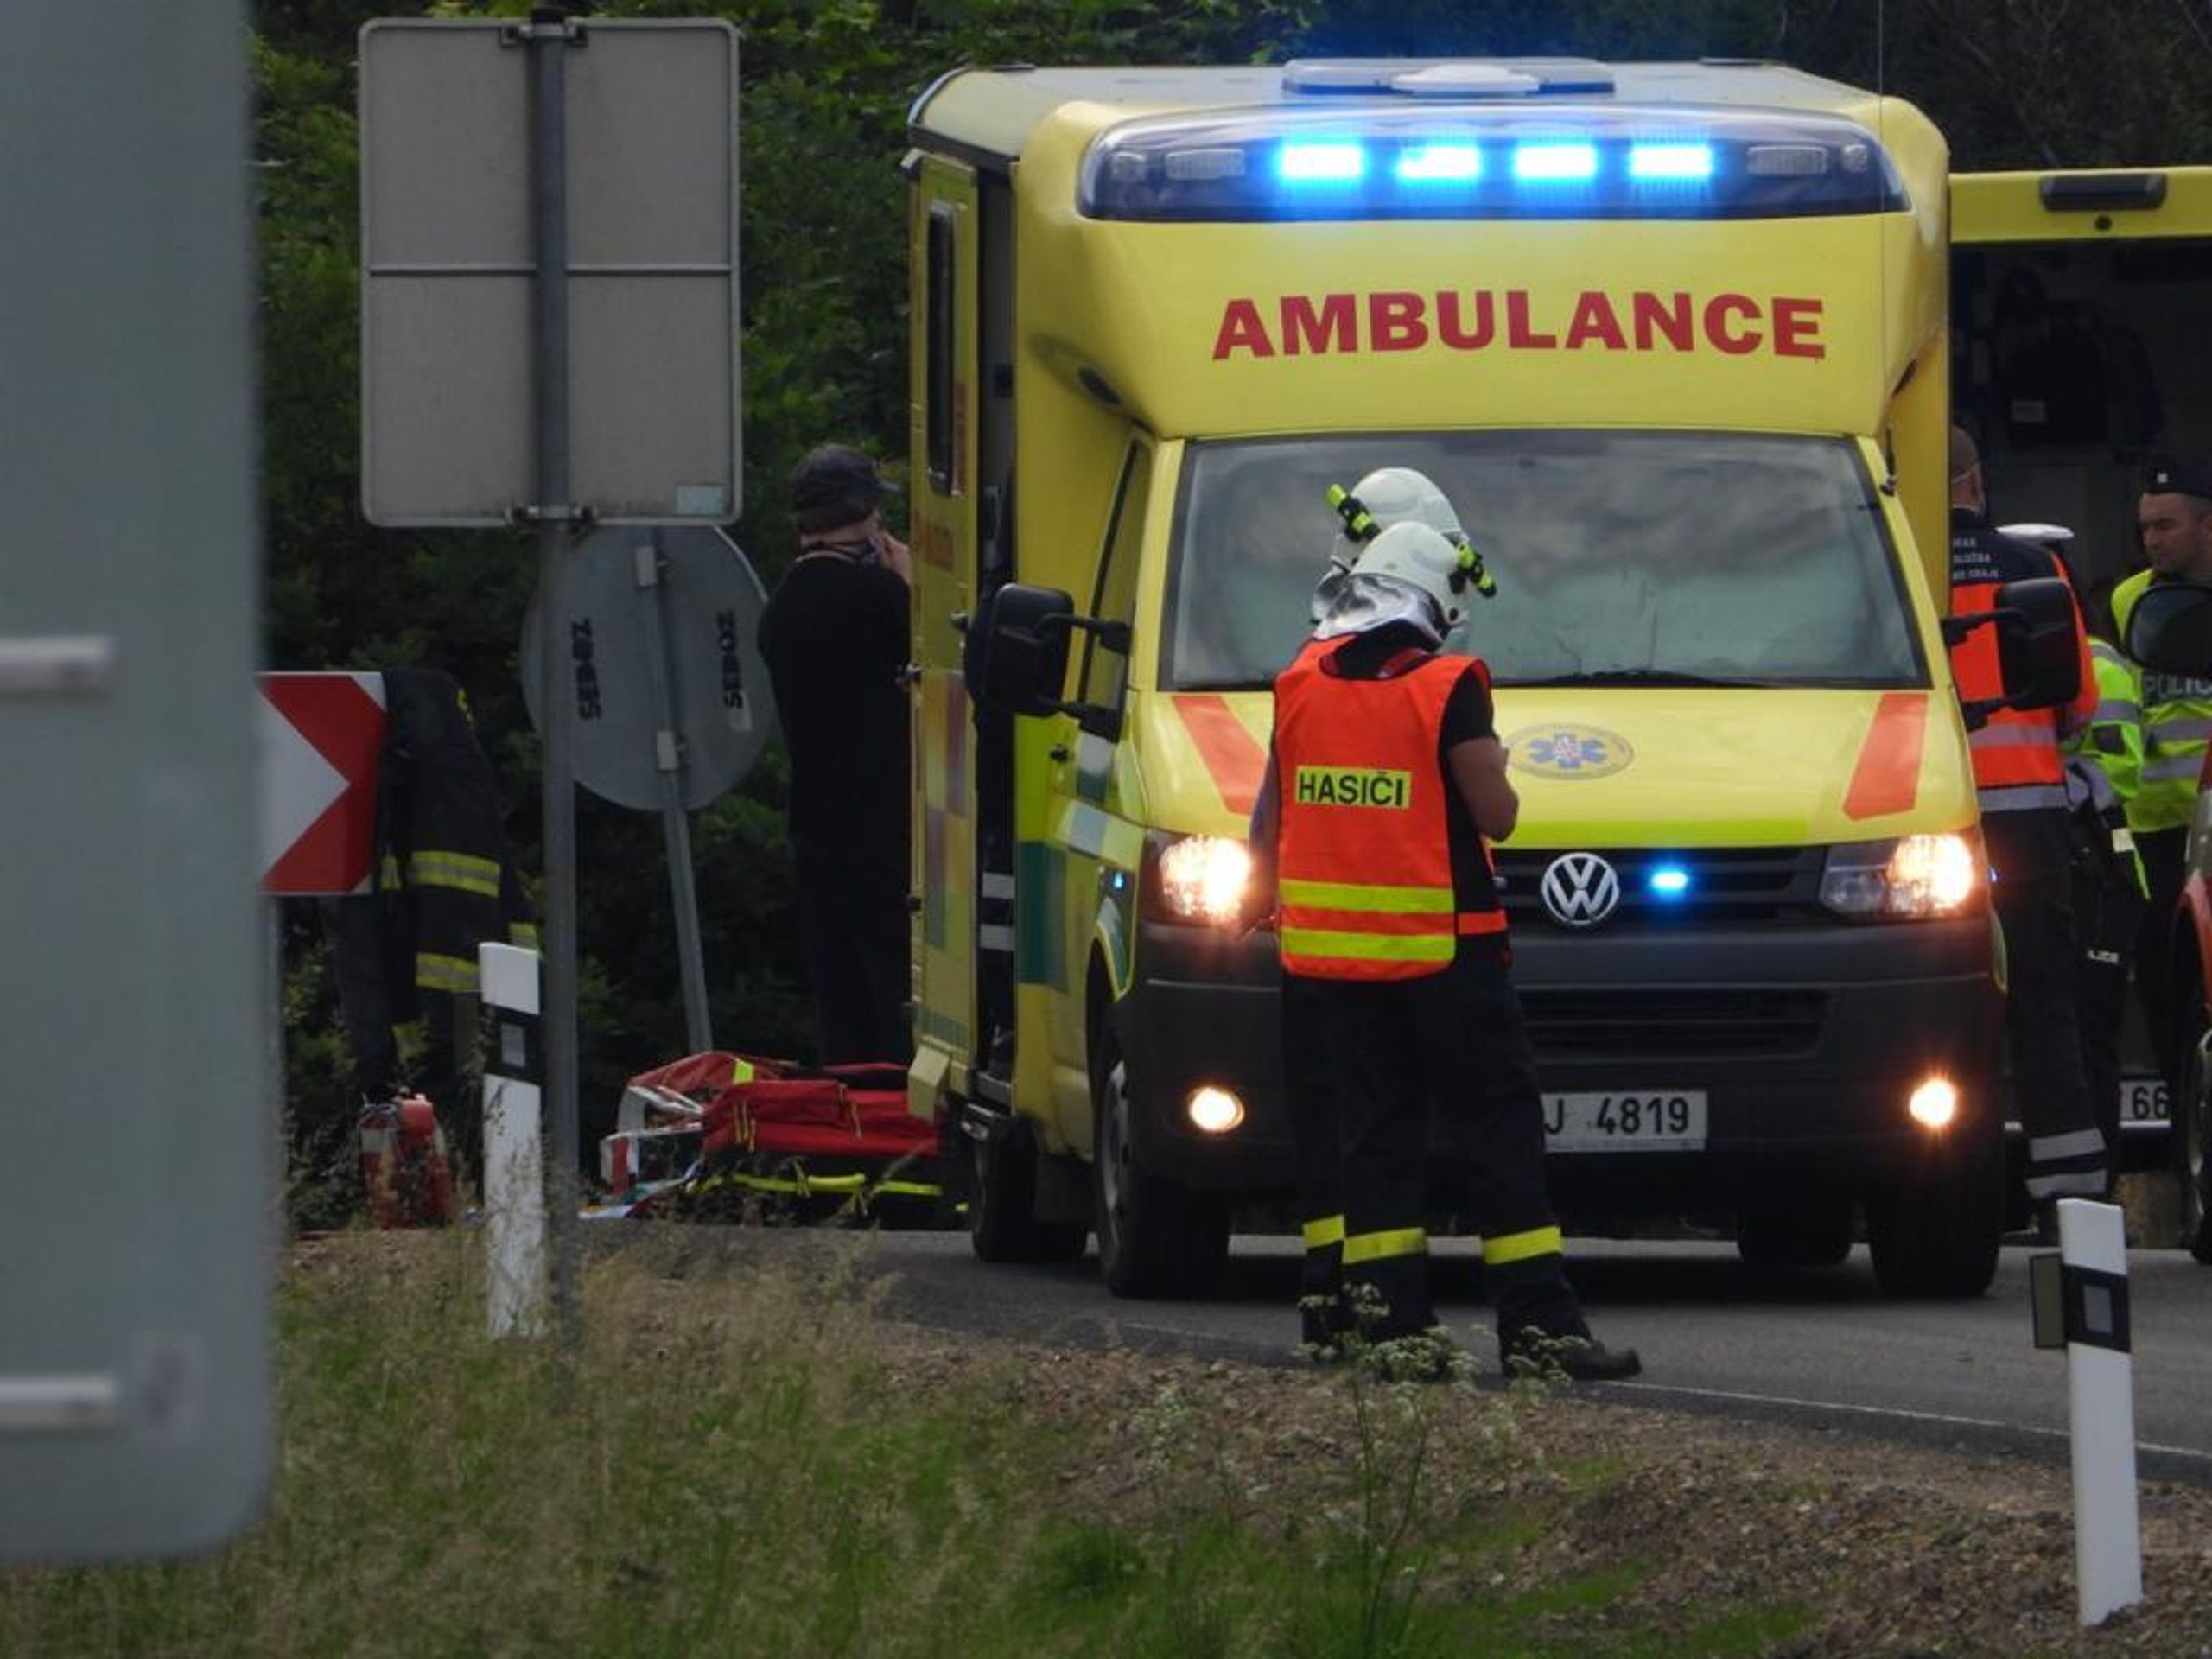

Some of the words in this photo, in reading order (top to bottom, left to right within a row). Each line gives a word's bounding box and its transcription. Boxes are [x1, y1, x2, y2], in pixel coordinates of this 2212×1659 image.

[1212, 290, 1826, 360] AMBULANCE
[1299, 771, 1403, 806] HASIČI
[1595, 1096, 1689, 1135] 4819
